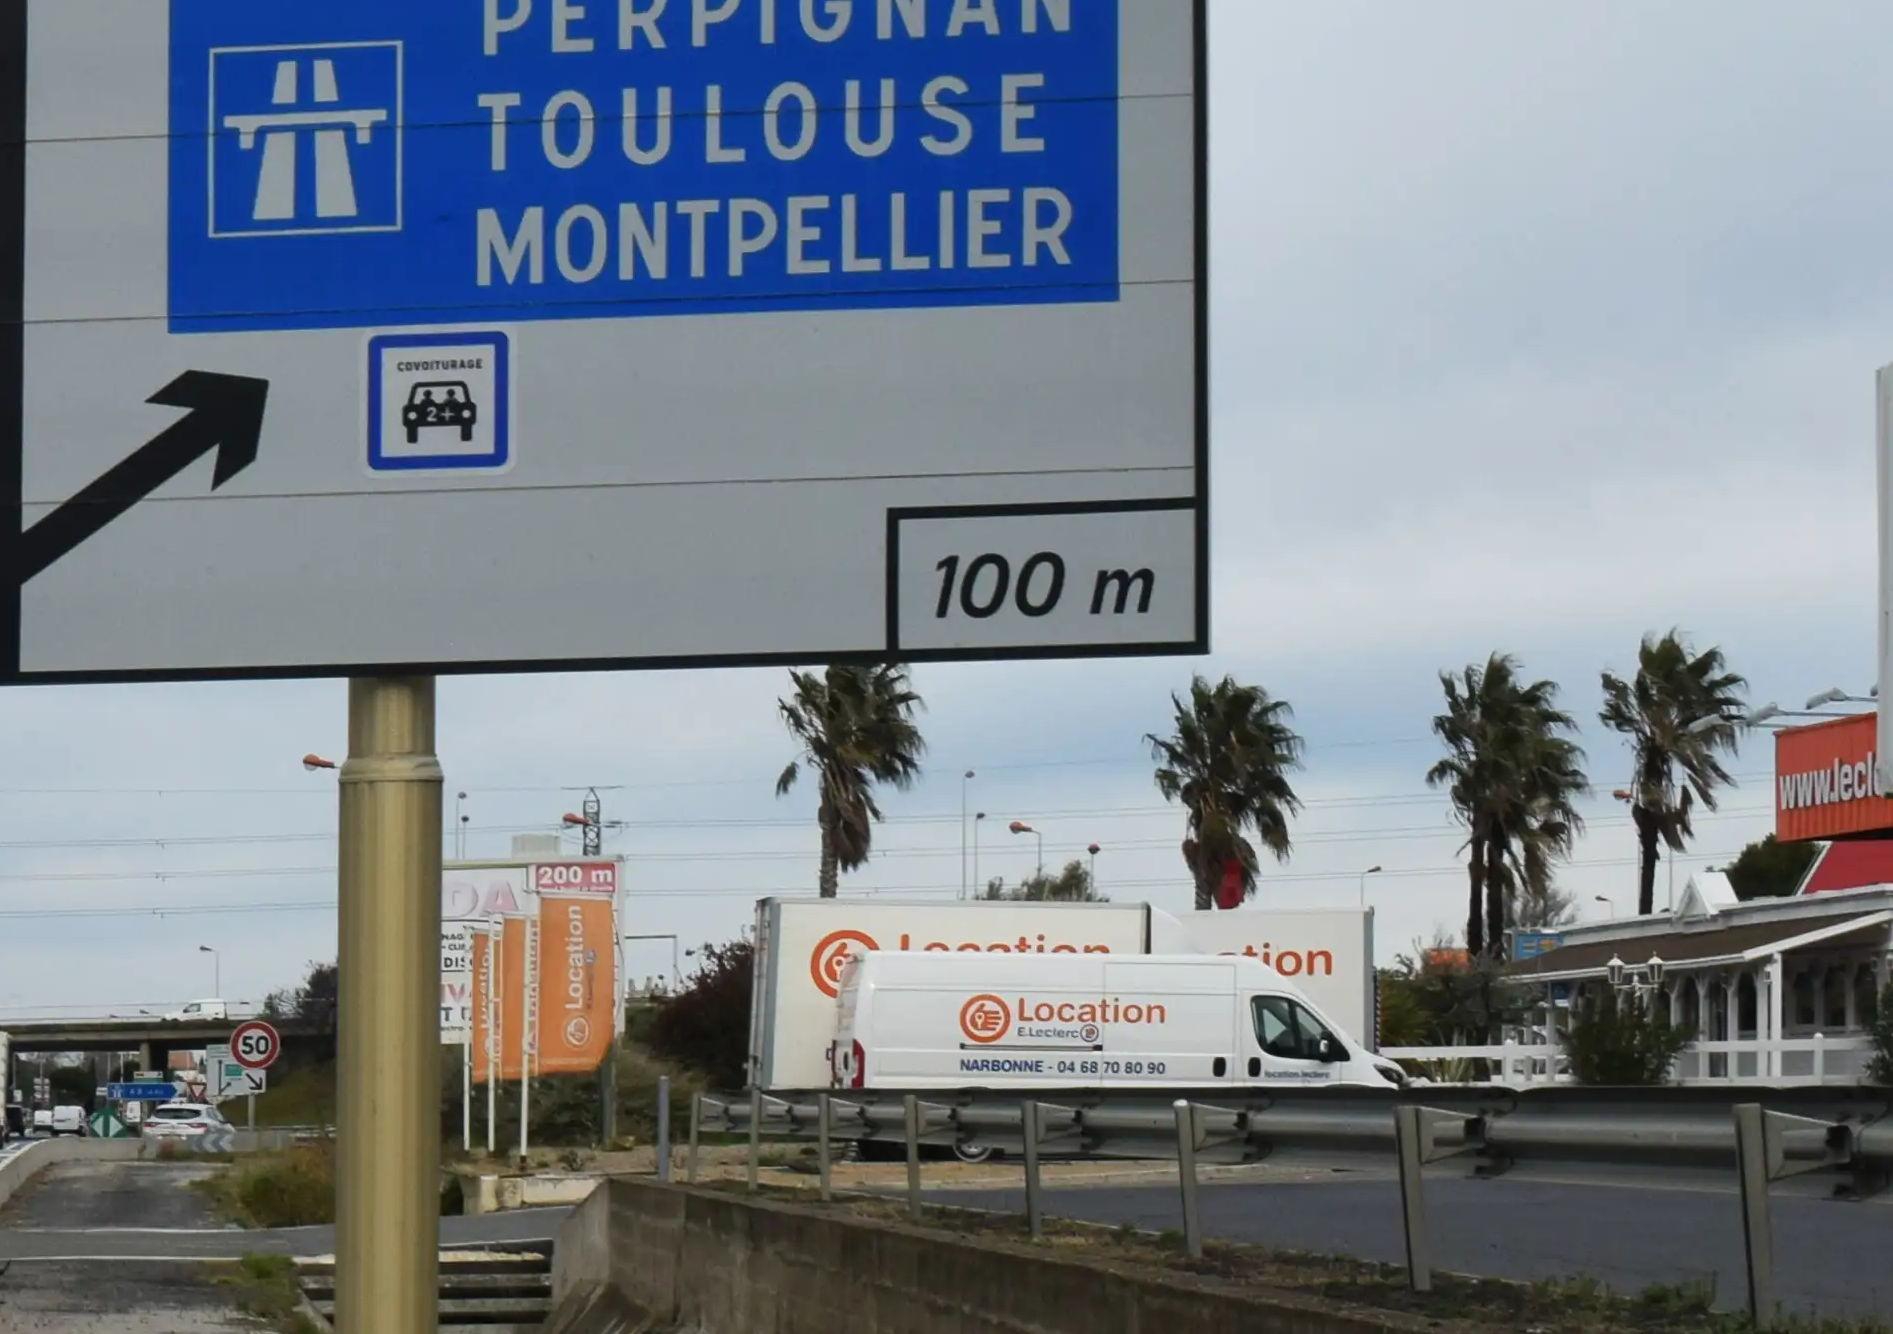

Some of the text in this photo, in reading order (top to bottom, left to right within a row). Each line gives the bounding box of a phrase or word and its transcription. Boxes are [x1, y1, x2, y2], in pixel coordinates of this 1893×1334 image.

[477, 73, 1045, 171] TOULOUSE
[476, 187, 1072, 287] MONTPELLIER
[396, 358, 483, 372] COVOITURAGE
[936, 551, 1155, 619] 100 m
[538, 866, 613, 884] 200 m
[564, 906, 584, 1009] Location
[1018, 997, 1166, 1024] Location
[1017, 1026, 1080, 1039] E.Leclerc
[241, 1036, 269, 1055] 50
[960, 1059, 1044, 1074] NARBONNE
[1057, 1061, 1076, 1074] 04
[1080, 1061, 1099, 1074] 68
[1103, 1061, 1120, 1075] 70
[1125, 1062, 1143, 1075] 80
[1147, 1063, 1166, 1075] 90
